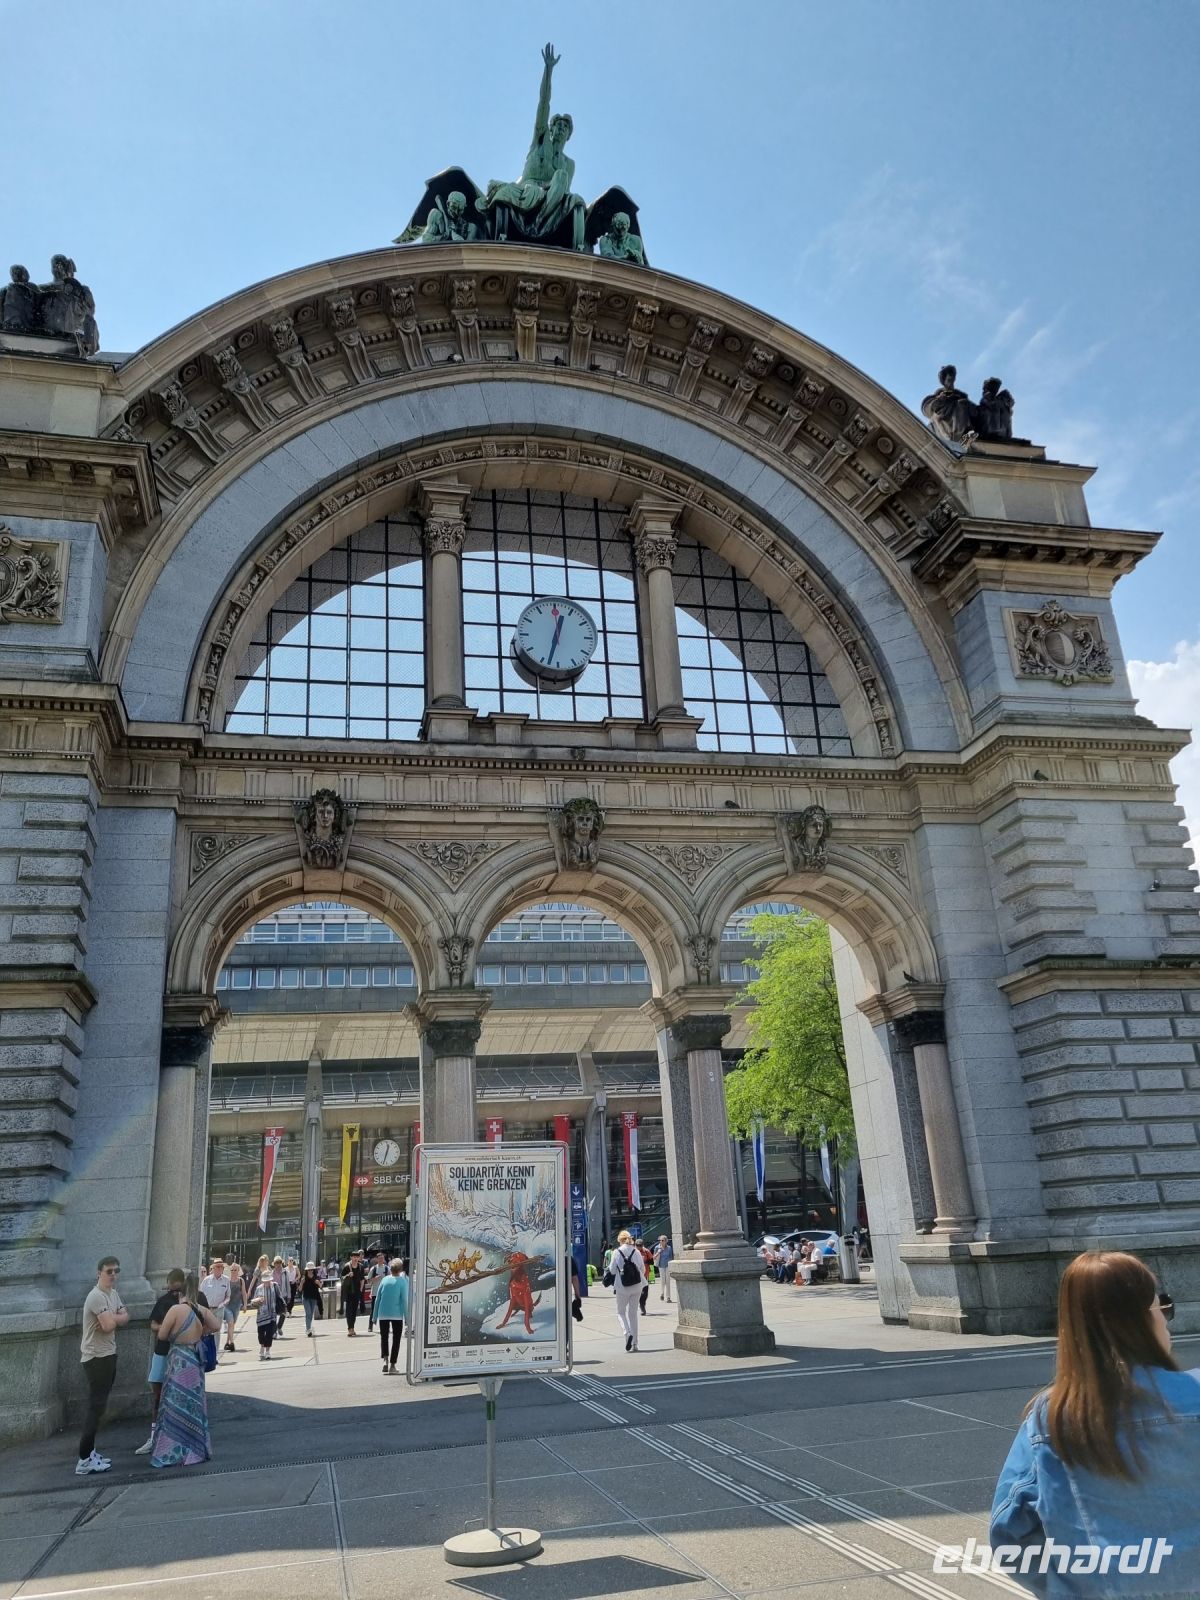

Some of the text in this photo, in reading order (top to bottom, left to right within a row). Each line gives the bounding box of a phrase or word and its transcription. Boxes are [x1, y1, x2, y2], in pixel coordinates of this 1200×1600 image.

[449, 1163, 536, 1179] SOLIDARITÄT KENNT
[373, 1175, 392, 1184] SBB
[458, 1178, 527, 1191] KEINE GRENZEN
[430, 1305, 452, 1314] JUNI
[429, 1314, 452, 1325] 2023
